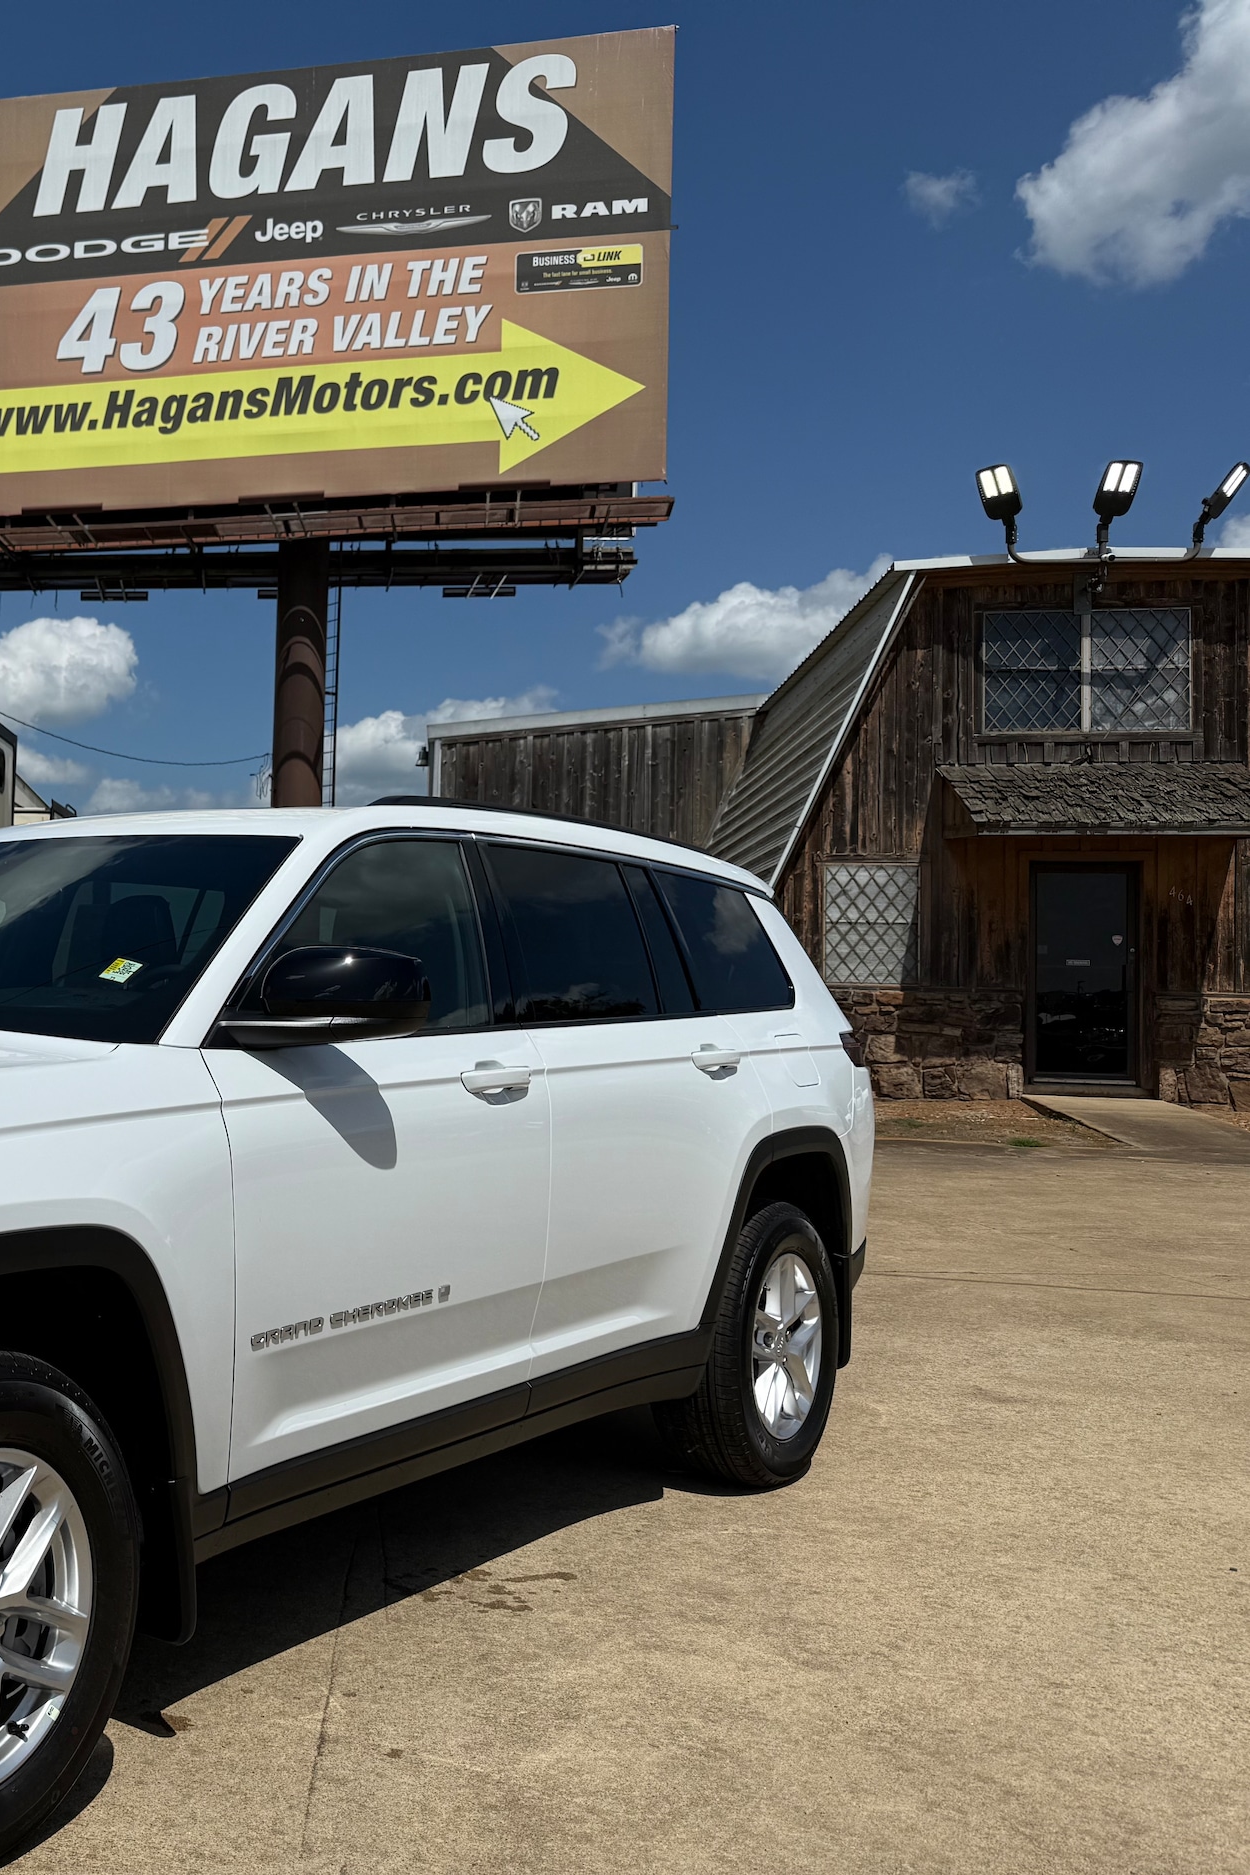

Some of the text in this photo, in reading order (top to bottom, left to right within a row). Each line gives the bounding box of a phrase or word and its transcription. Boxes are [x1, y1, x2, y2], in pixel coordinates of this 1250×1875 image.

[32, 53, 577, 218] HAGANS
[356, 204, 471, 221] CHRYSLER
[551, 198, 648, 219] RAM
[254, 218, 324, 243] Jeep
[532, 250, 622, 267] BUSINESS LINK
[198, 256, 488, 316] YEARS IN THE
[56, 280, 186, 375] 43
[192, 304, 493, 364] RIVER VALLEY
[1169, 885, 1193, 906] 464
[250, 1316, 325, 1352] GRAND
[329, 1288, 434, 1330] CHEROKEE
